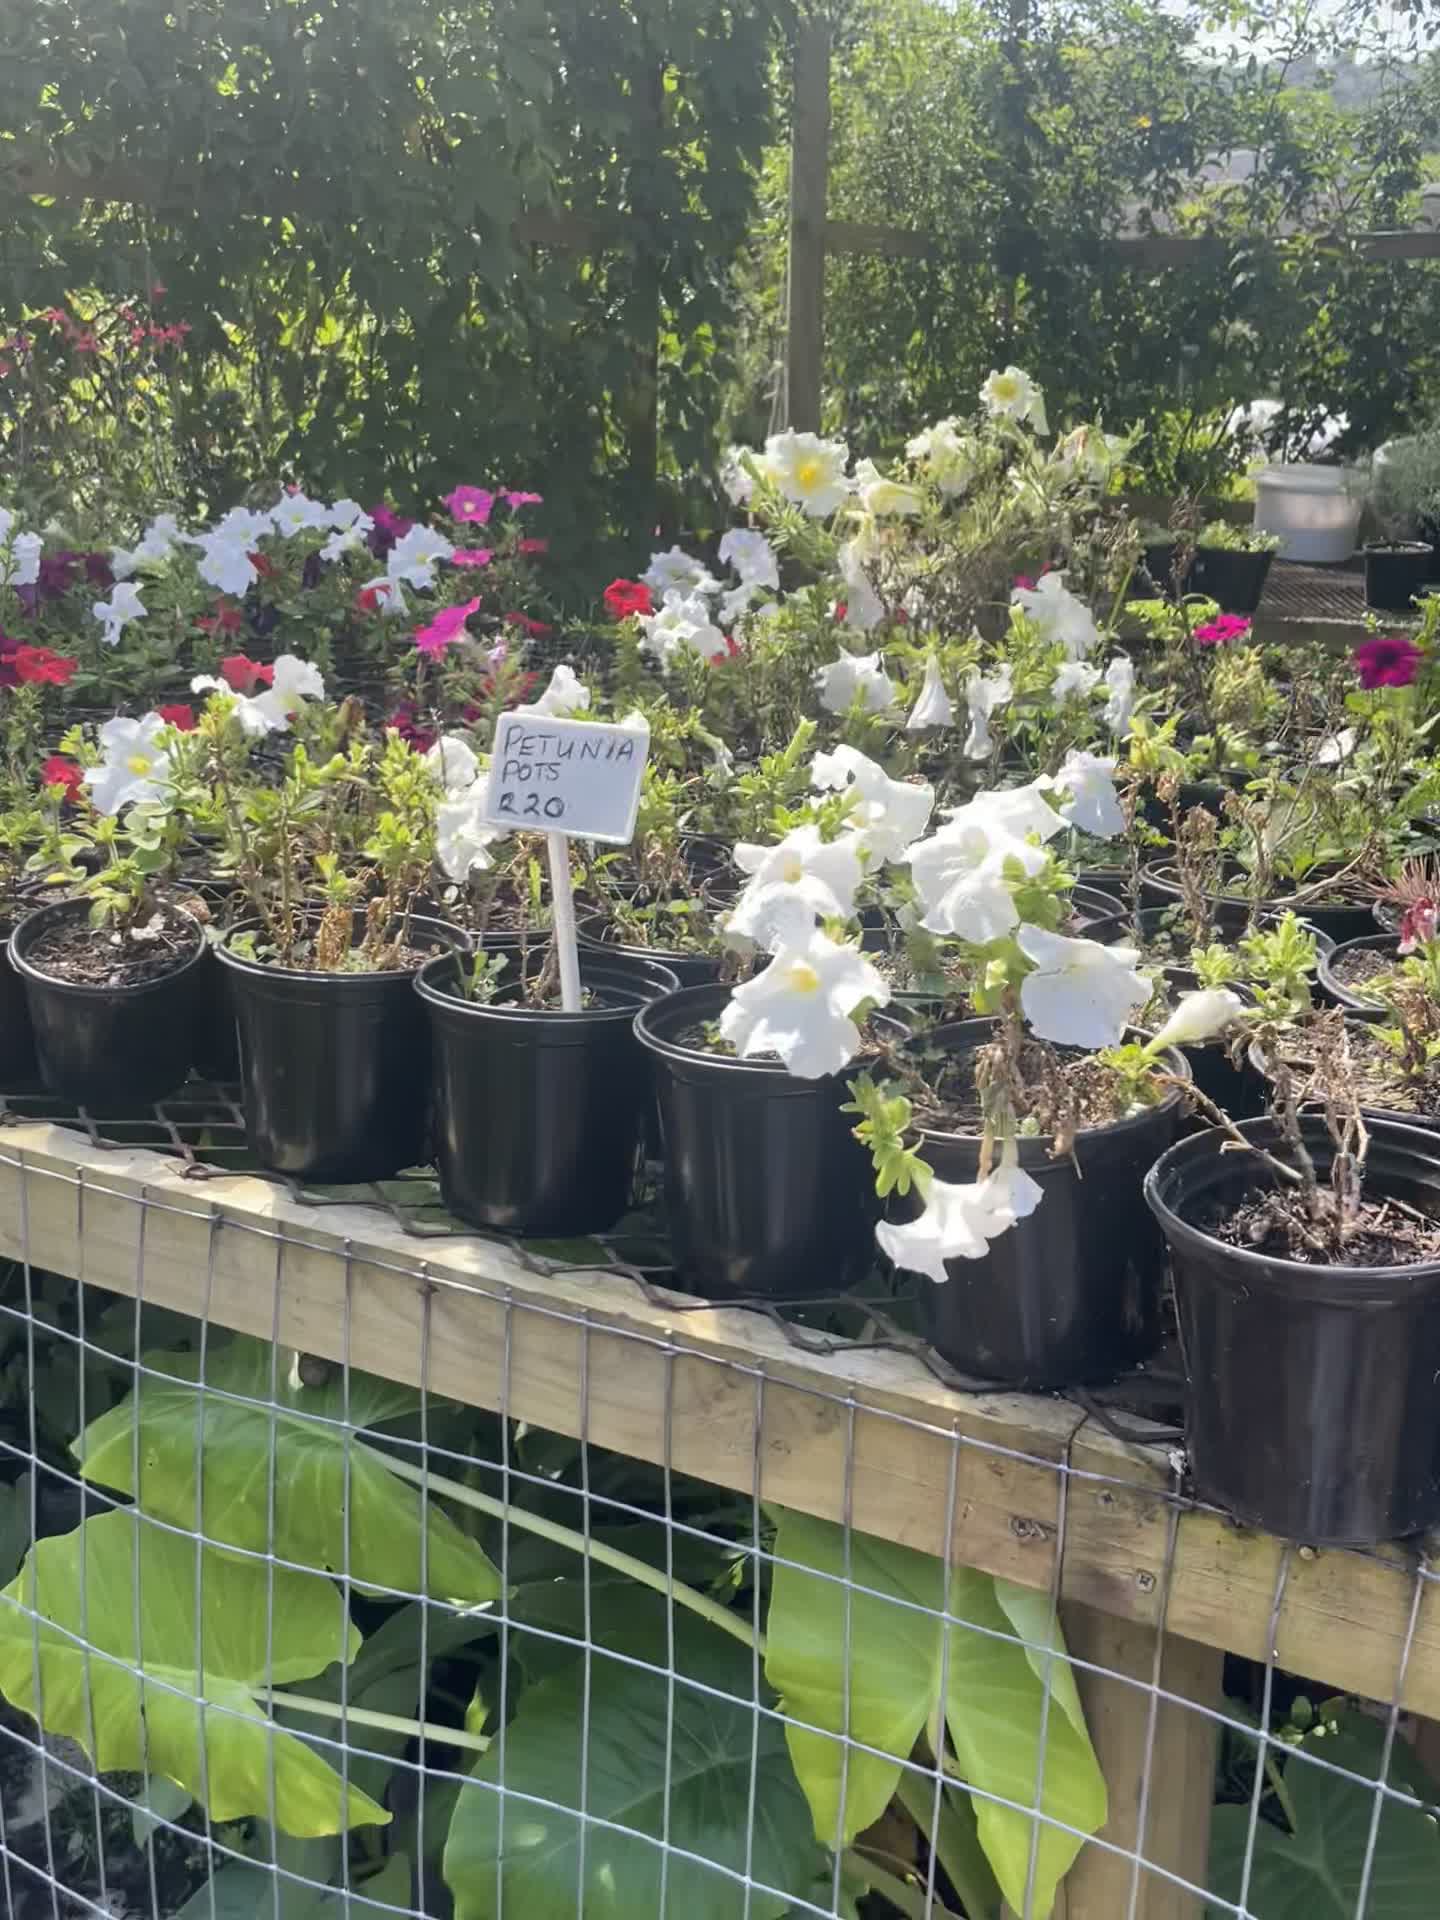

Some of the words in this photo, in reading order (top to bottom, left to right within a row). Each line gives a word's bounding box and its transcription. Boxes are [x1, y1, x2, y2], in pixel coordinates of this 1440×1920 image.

[504, 724, 634, 761] PETUNIA
[502, 760, 561, 783] POTS
[498, 792, 565, 818] R20
